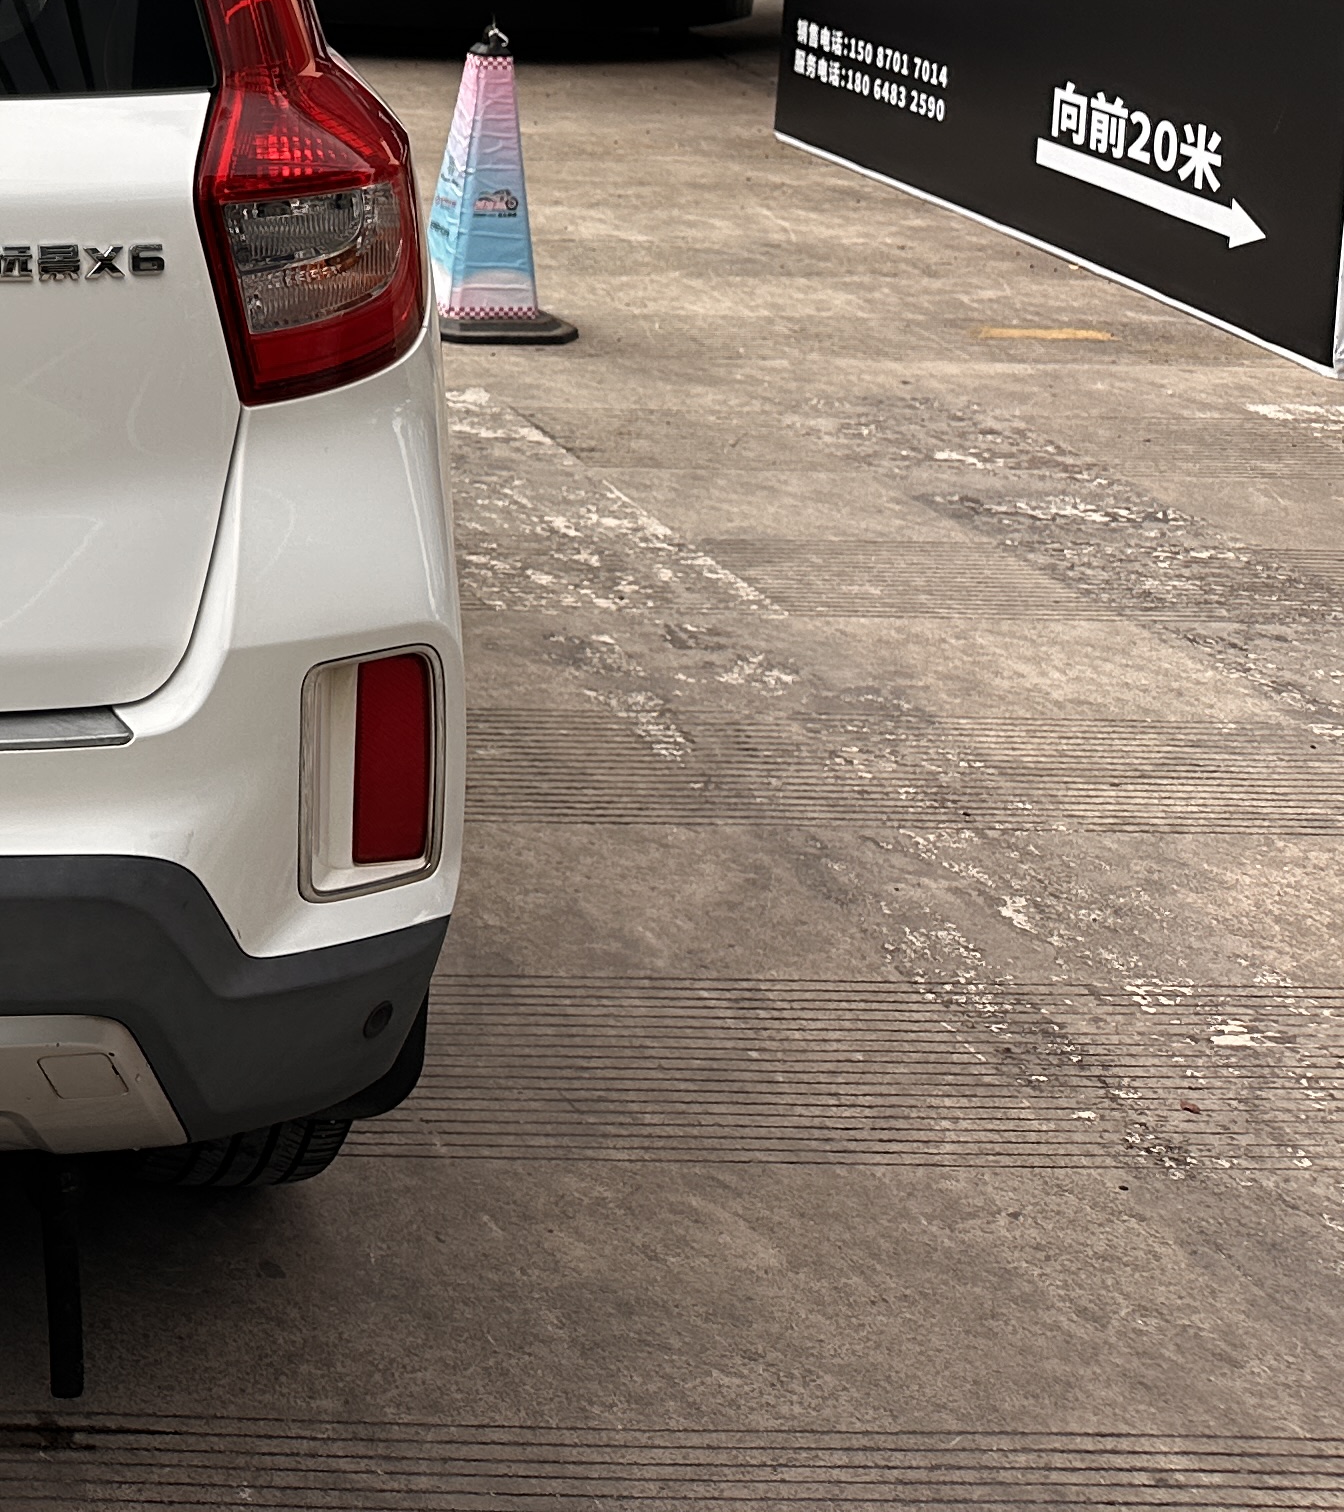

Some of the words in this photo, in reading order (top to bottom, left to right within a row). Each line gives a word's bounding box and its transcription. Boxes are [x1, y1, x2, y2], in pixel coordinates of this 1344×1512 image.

[875, 45, 910, 77] 8701
[913, 55, 949, 89] 7014
[873, 78, 907, 109] 6483
[909, 89, 946, 122] 2590
[1050, 81, 1223, 193] 向前20米
